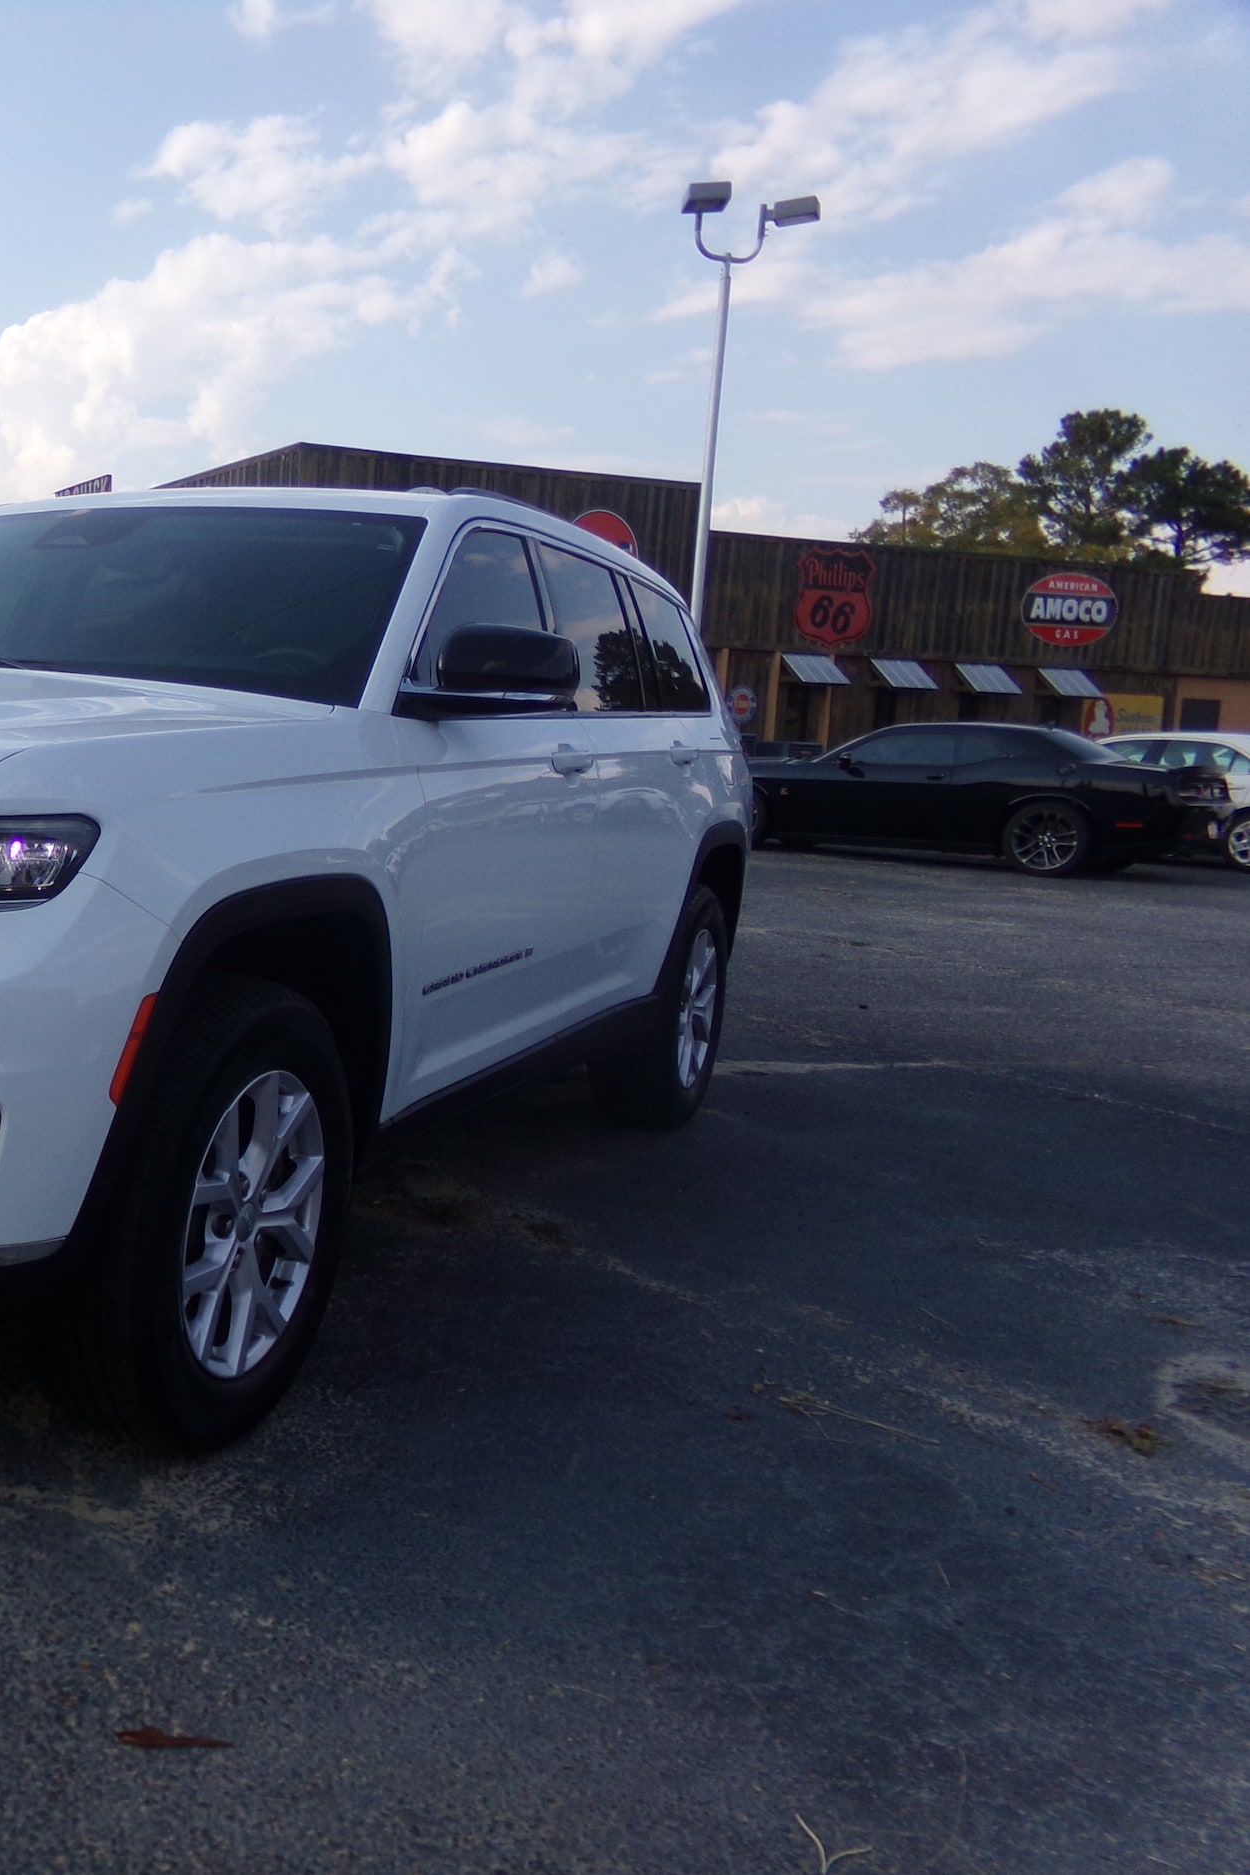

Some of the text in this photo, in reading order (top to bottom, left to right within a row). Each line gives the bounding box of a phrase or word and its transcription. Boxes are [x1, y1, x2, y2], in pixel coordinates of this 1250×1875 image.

[805, 559, 865, 592] Phillips
[1048, 581, 1099, 592] AMERICAN
[810, 595, 856, 635] 66
[1030, 597, 1108, 623] AMOCO
[1055, 629, 1079, 639] GAS
